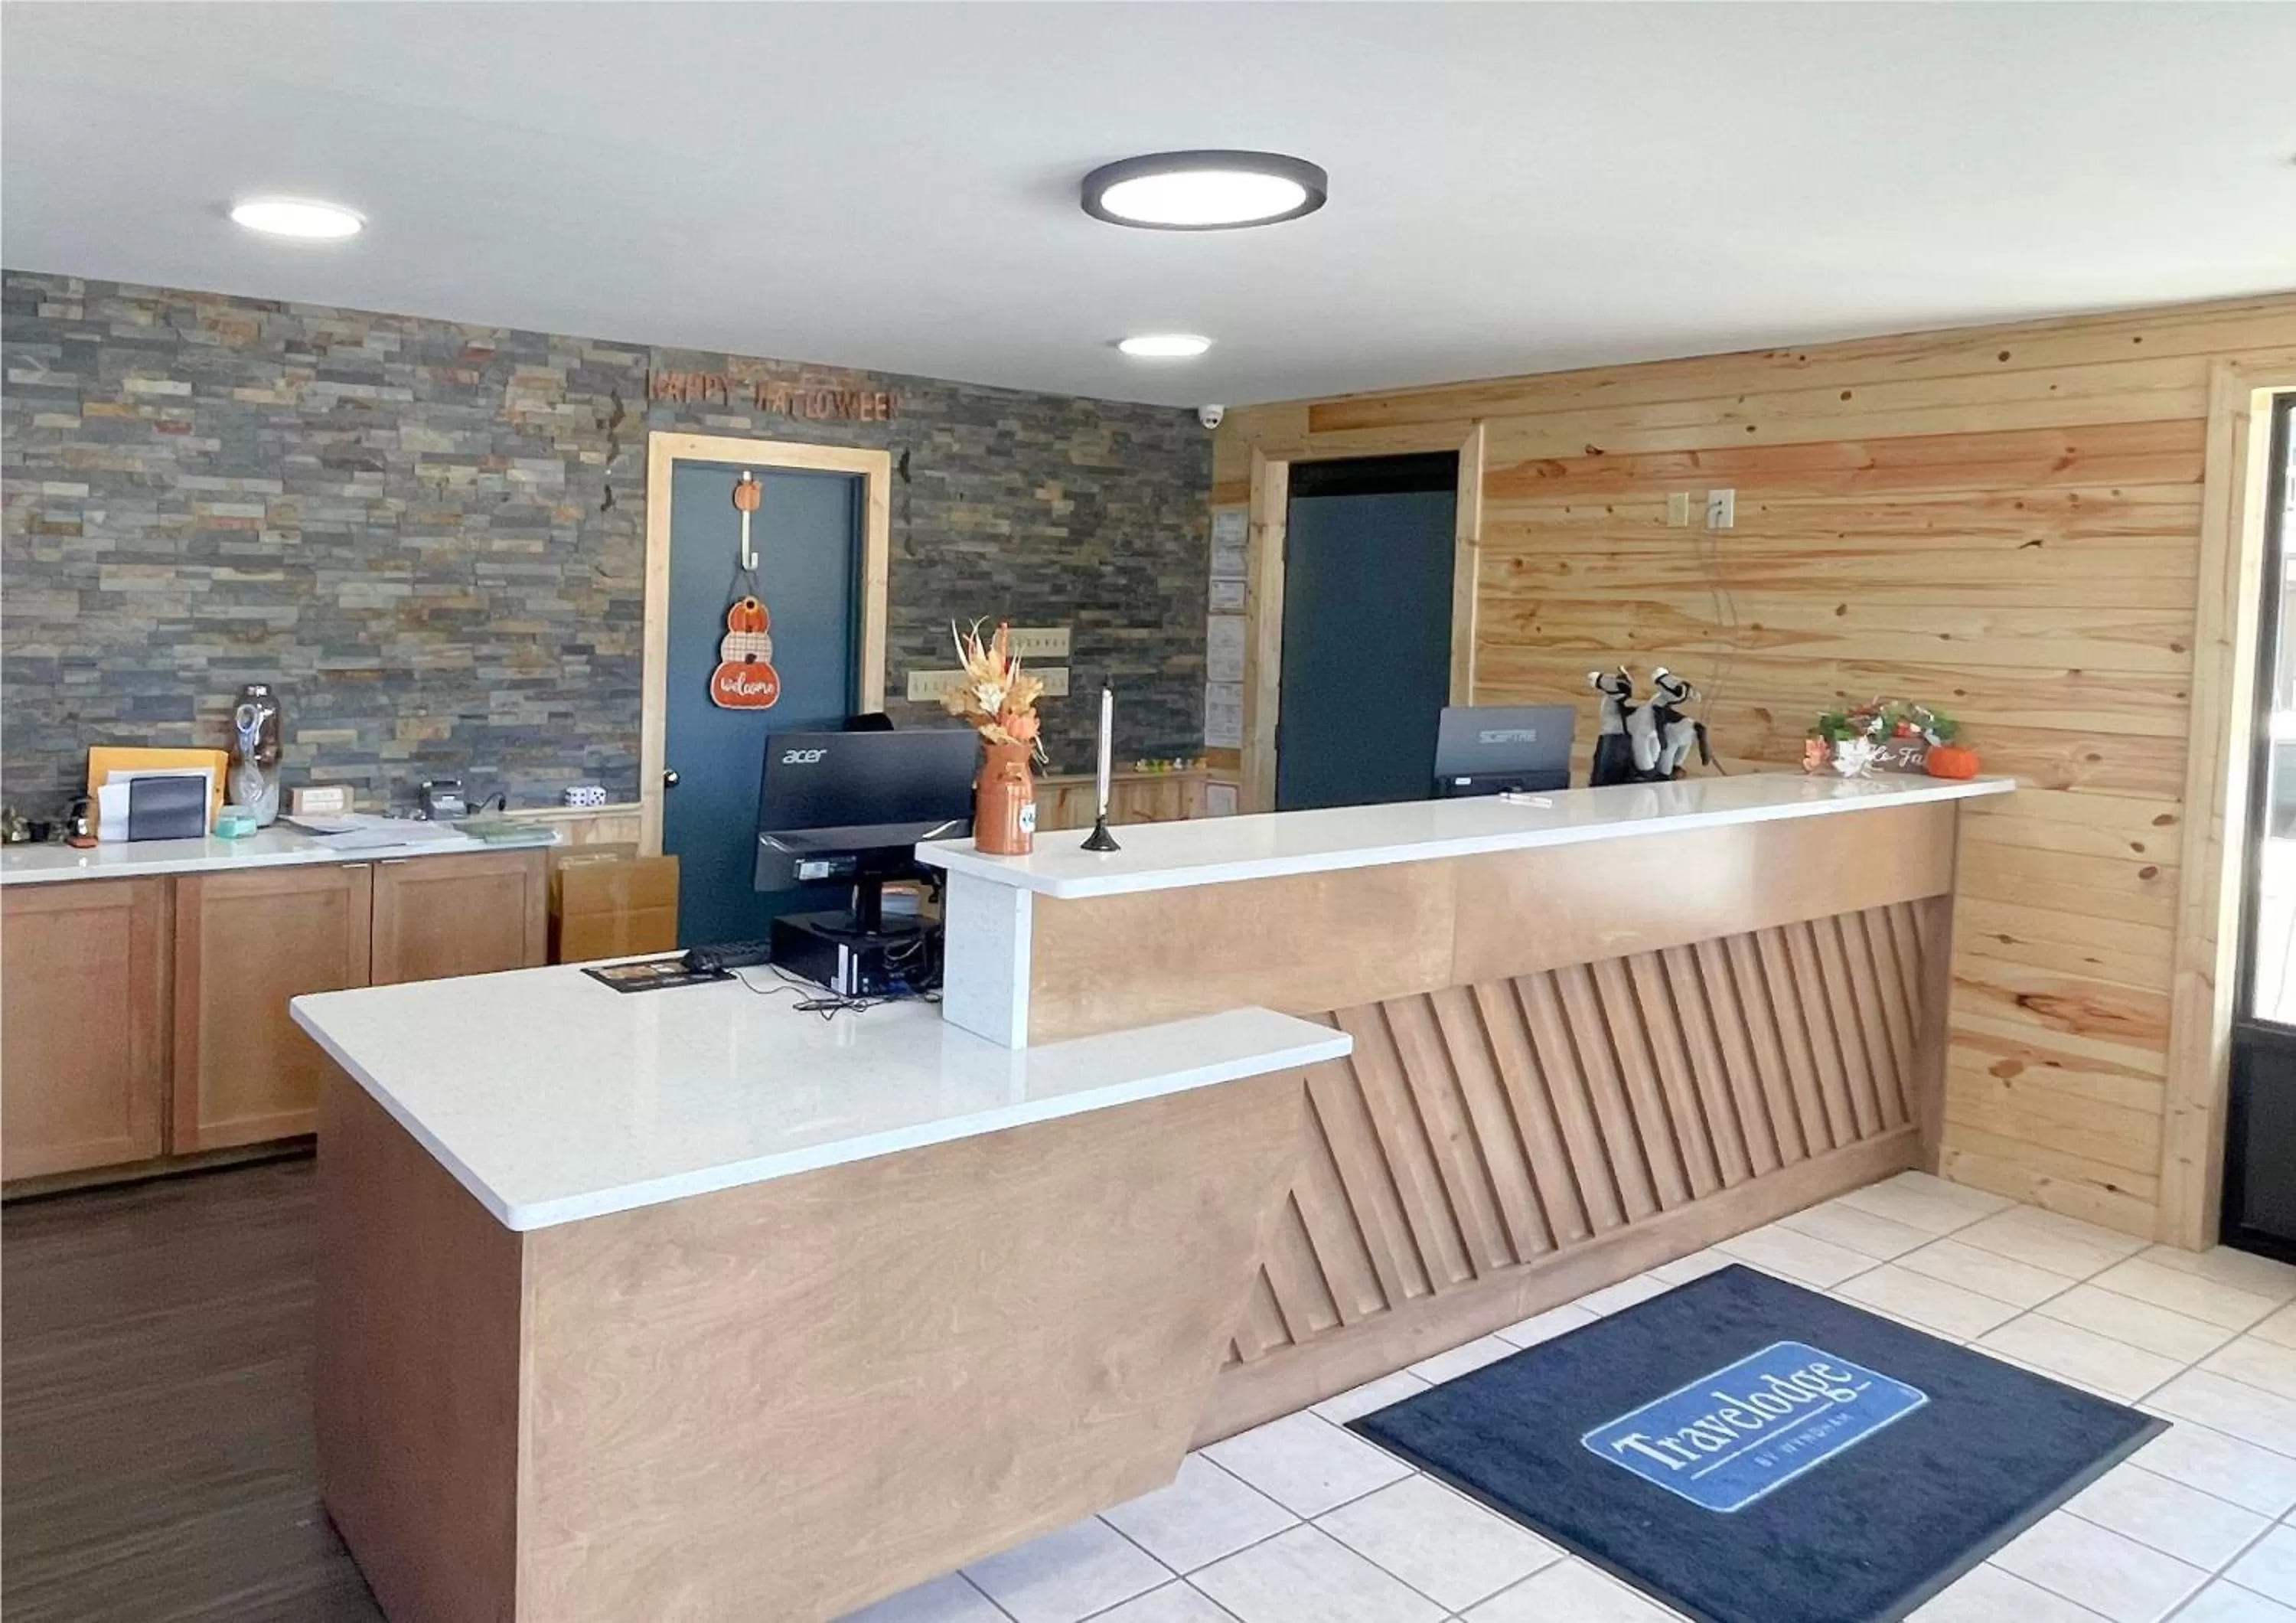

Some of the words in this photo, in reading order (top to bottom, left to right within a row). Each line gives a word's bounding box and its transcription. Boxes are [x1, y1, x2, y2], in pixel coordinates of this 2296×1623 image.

[720, 671, 774, 695] welcome
[782, 749, 827, 764] acer
[1611, 1362, 1857, 1471] Travelodge
[1753, 1452, 1779, 1468] BY
